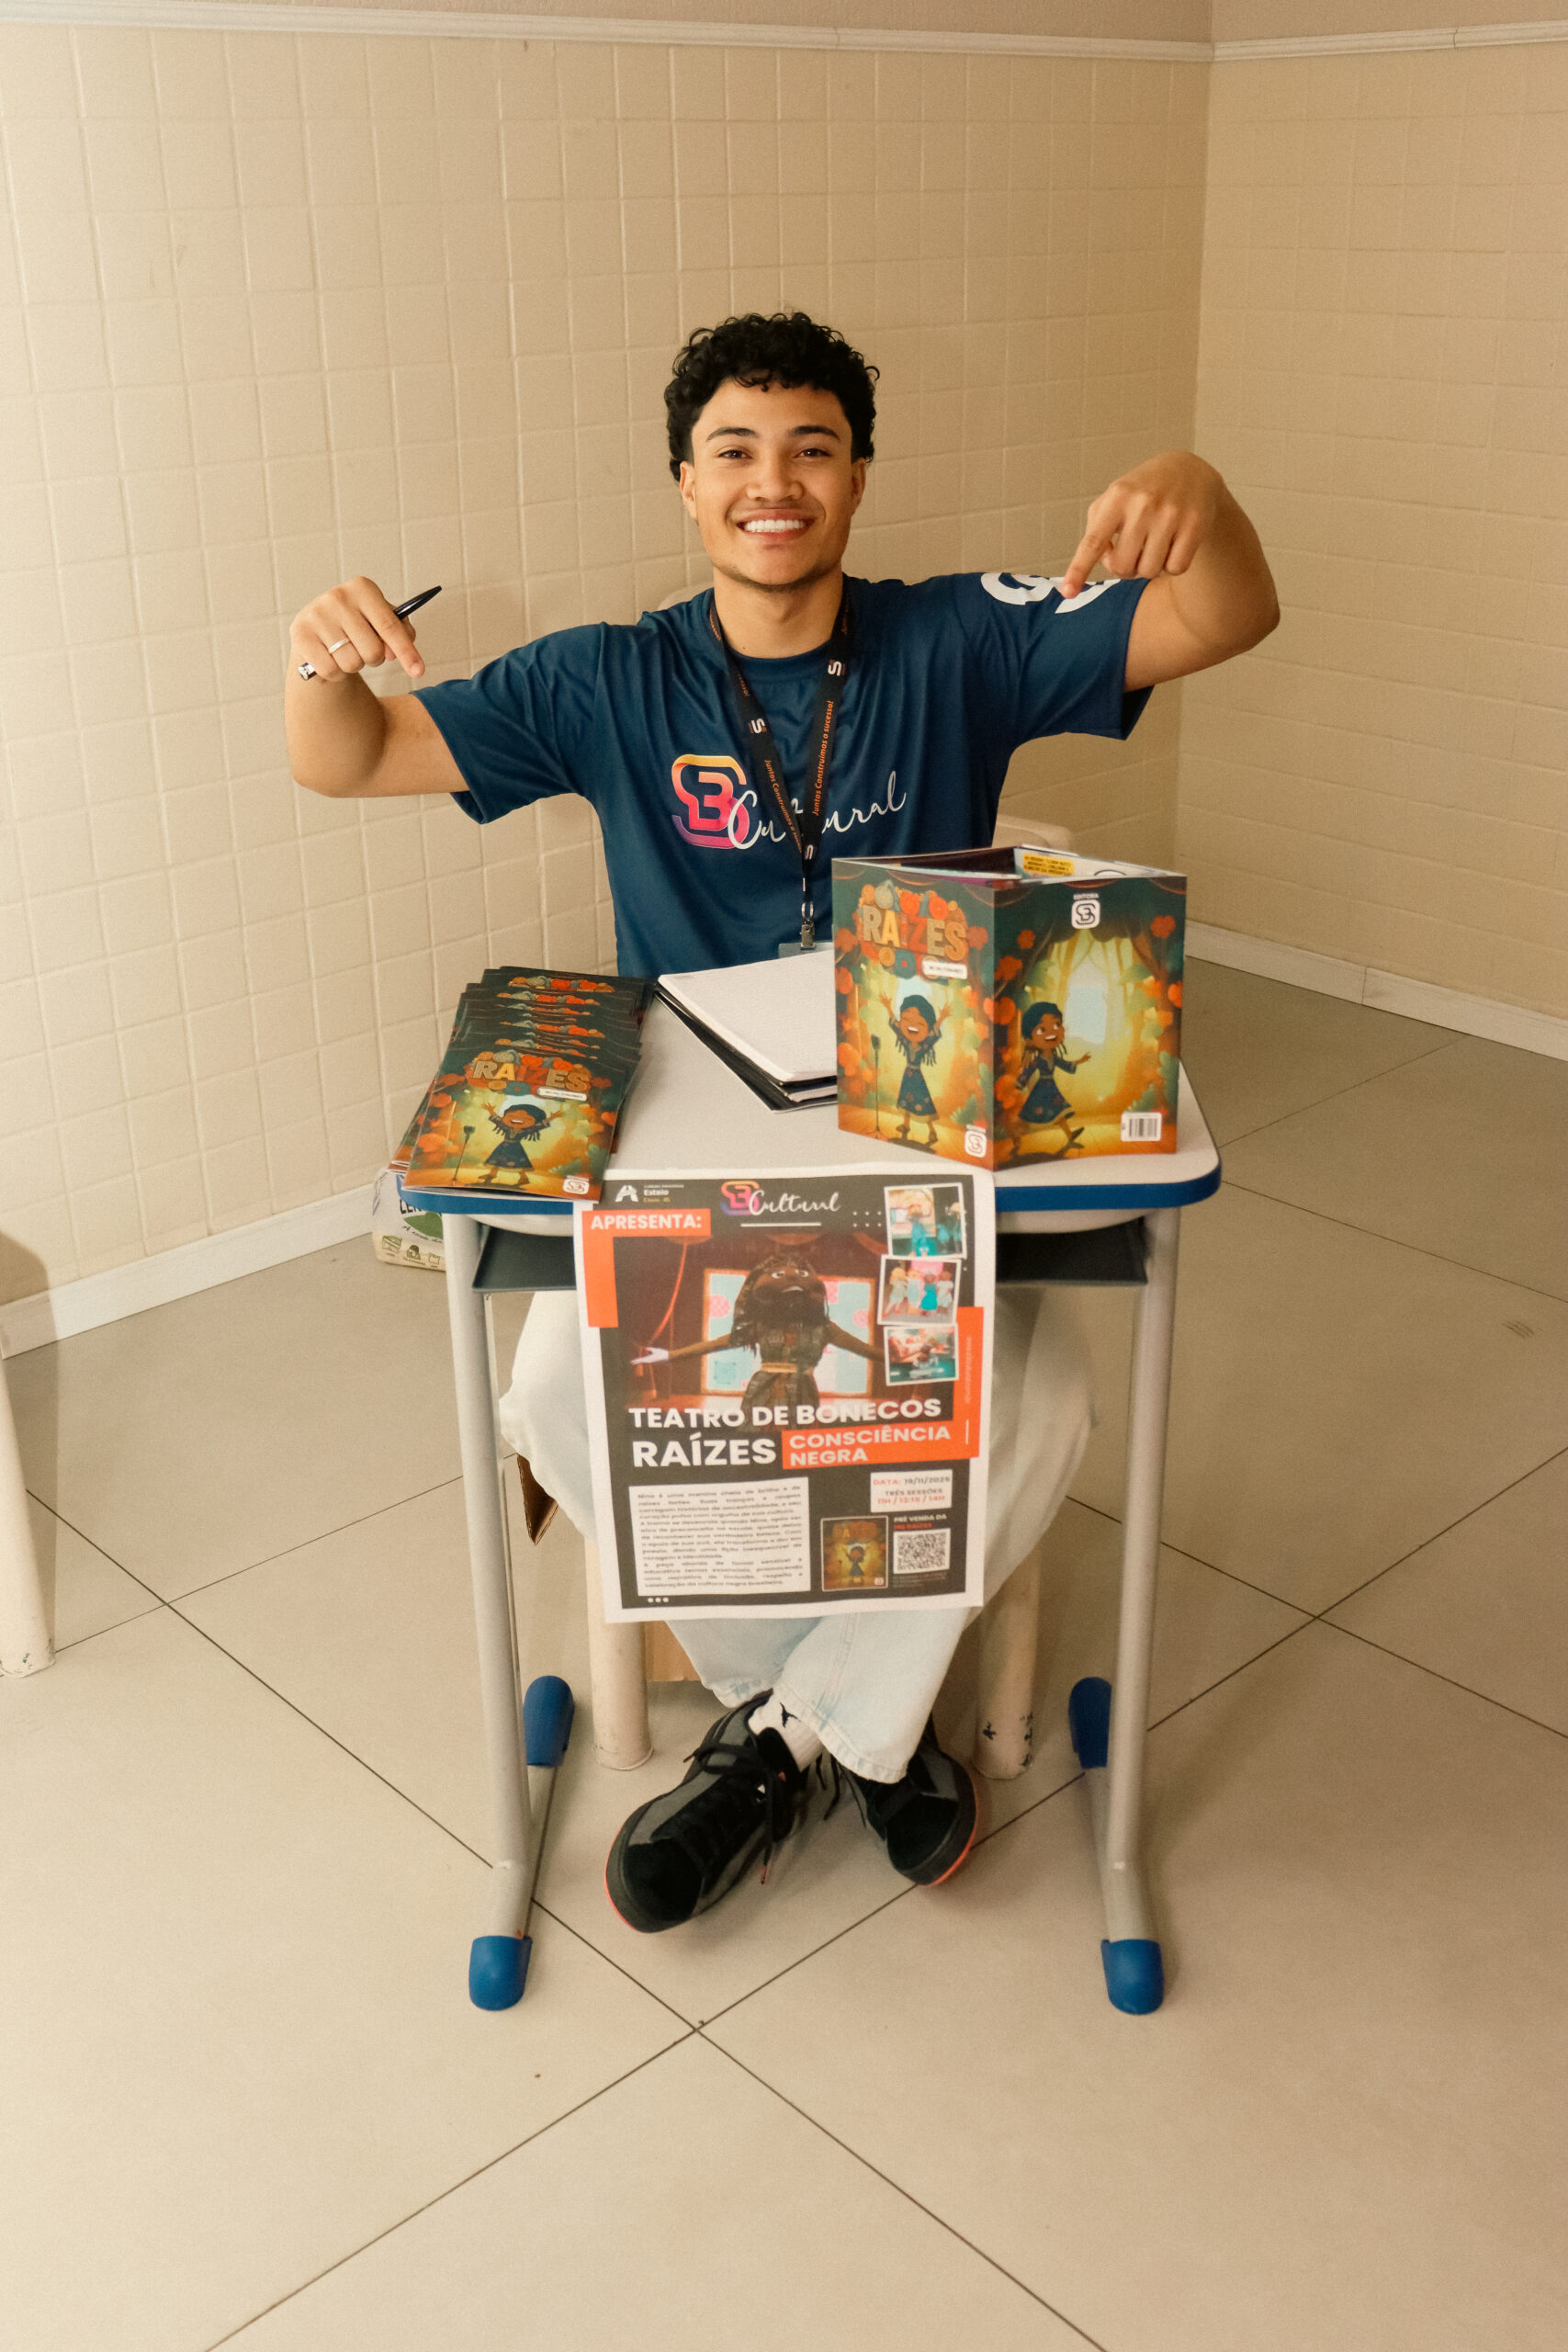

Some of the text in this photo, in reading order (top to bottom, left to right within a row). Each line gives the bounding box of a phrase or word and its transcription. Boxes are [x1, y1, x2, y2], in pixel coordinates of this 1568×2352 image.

[764, 759, 777, 783] Juntos
[812, 790, 822, 816] Juntos
[823, 700, 834, 732] sucesso!
[591, 1213, 703, 1230] APRESENTA:
[628, 1398, 942, 1430] TEATRO DE BONECOS
[632, 1425, 952, 1468] RAÍZES CONSCIÊNCIA
[789, 1448, 869, 1467] NEGRA
